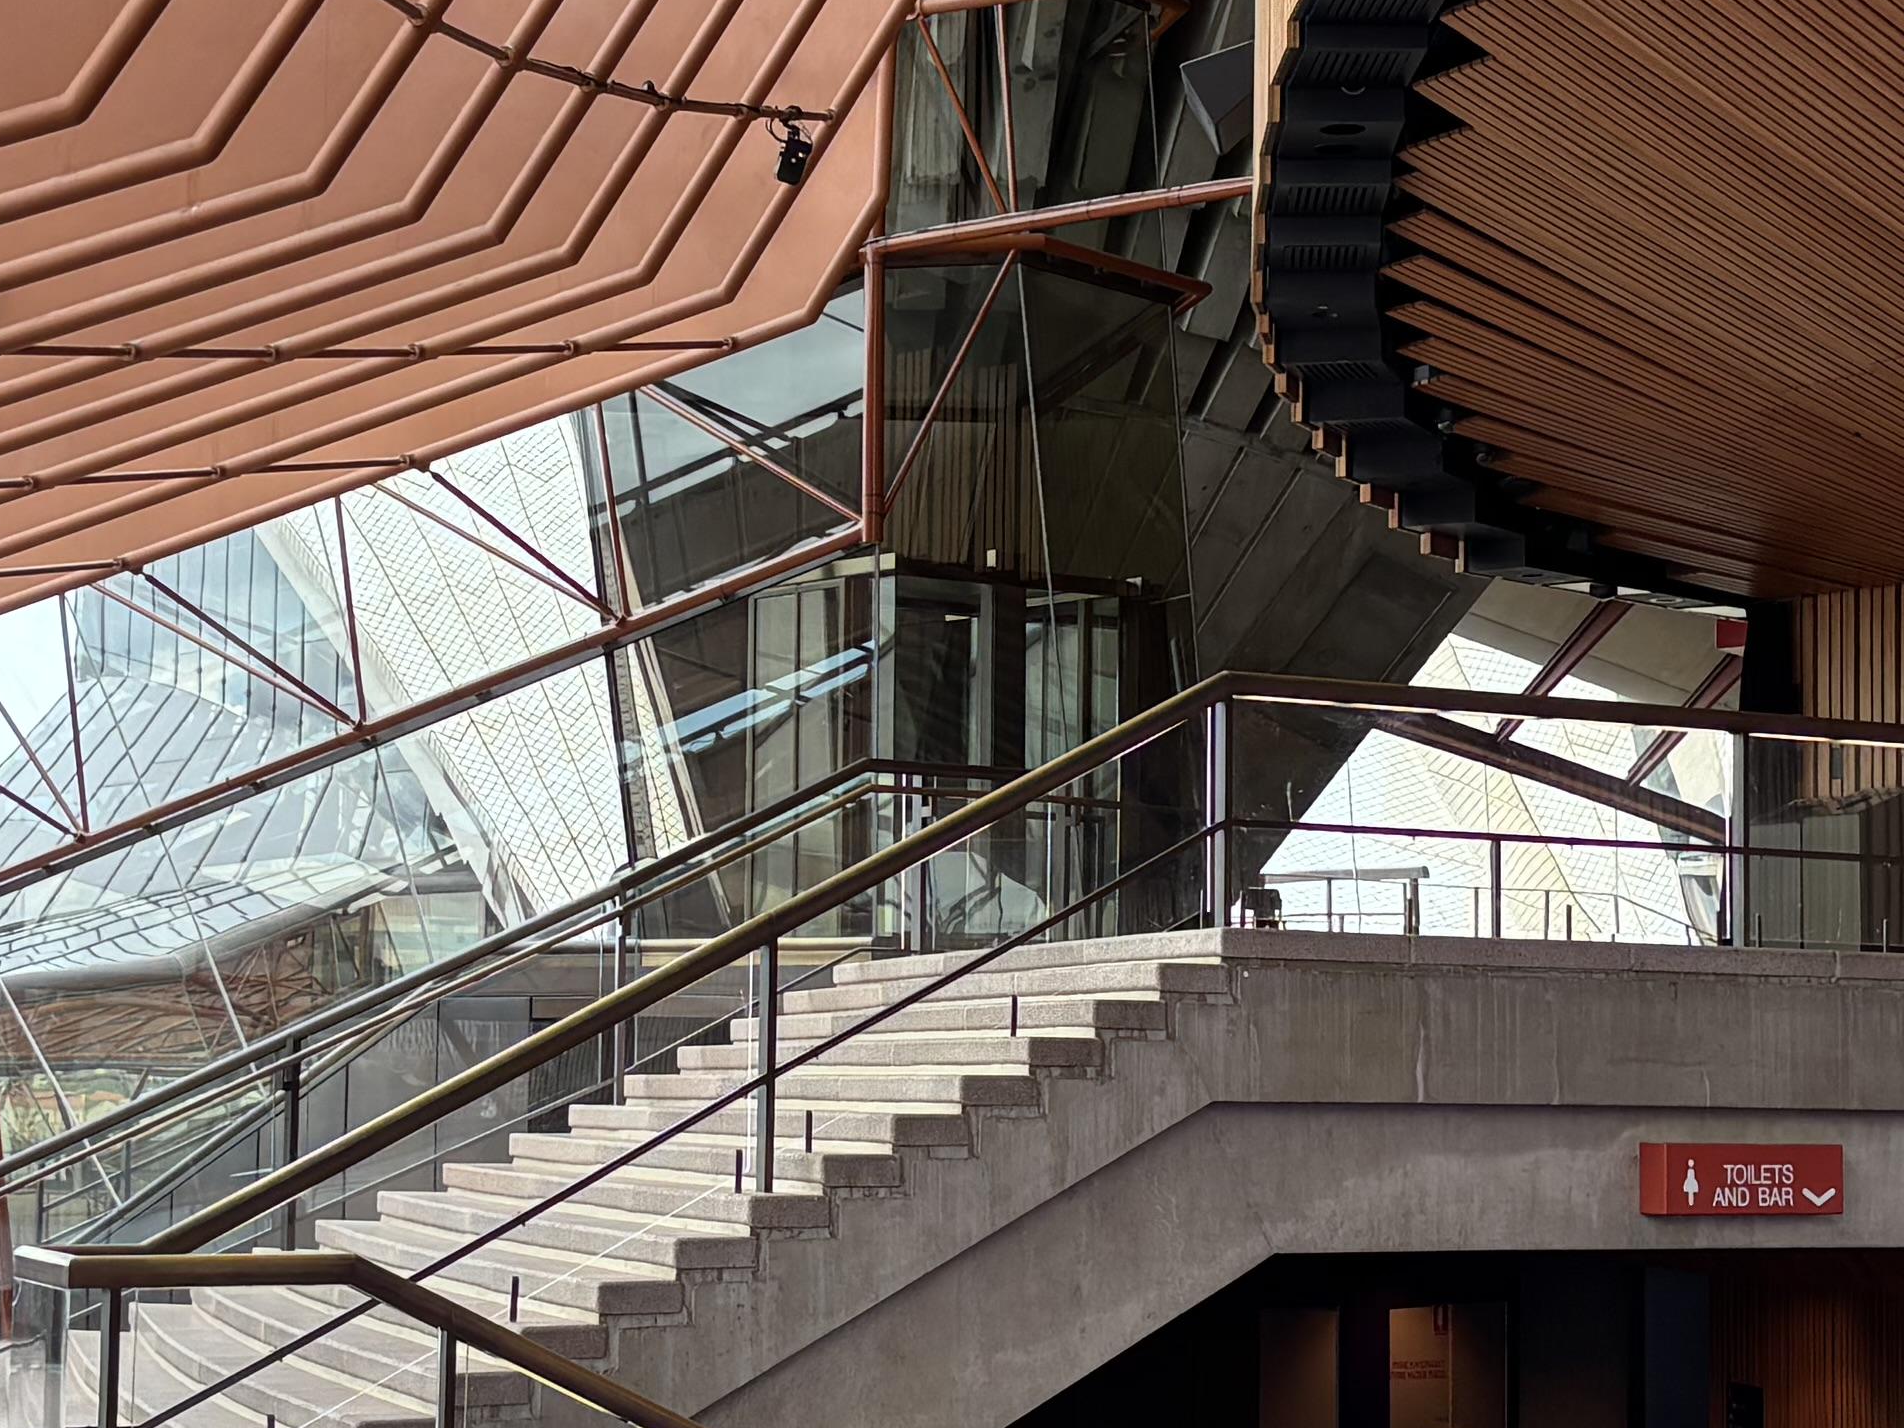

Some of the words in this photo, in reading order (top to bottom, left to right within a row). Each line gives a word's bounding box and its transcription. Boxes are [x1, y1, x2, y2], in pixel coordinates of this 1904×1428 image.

[1723, 1164, 1794, 1185] TOILETS
[1712, 1187, 1750, 1207] AND
[1758, 1187, 1794, 1207] BAR
